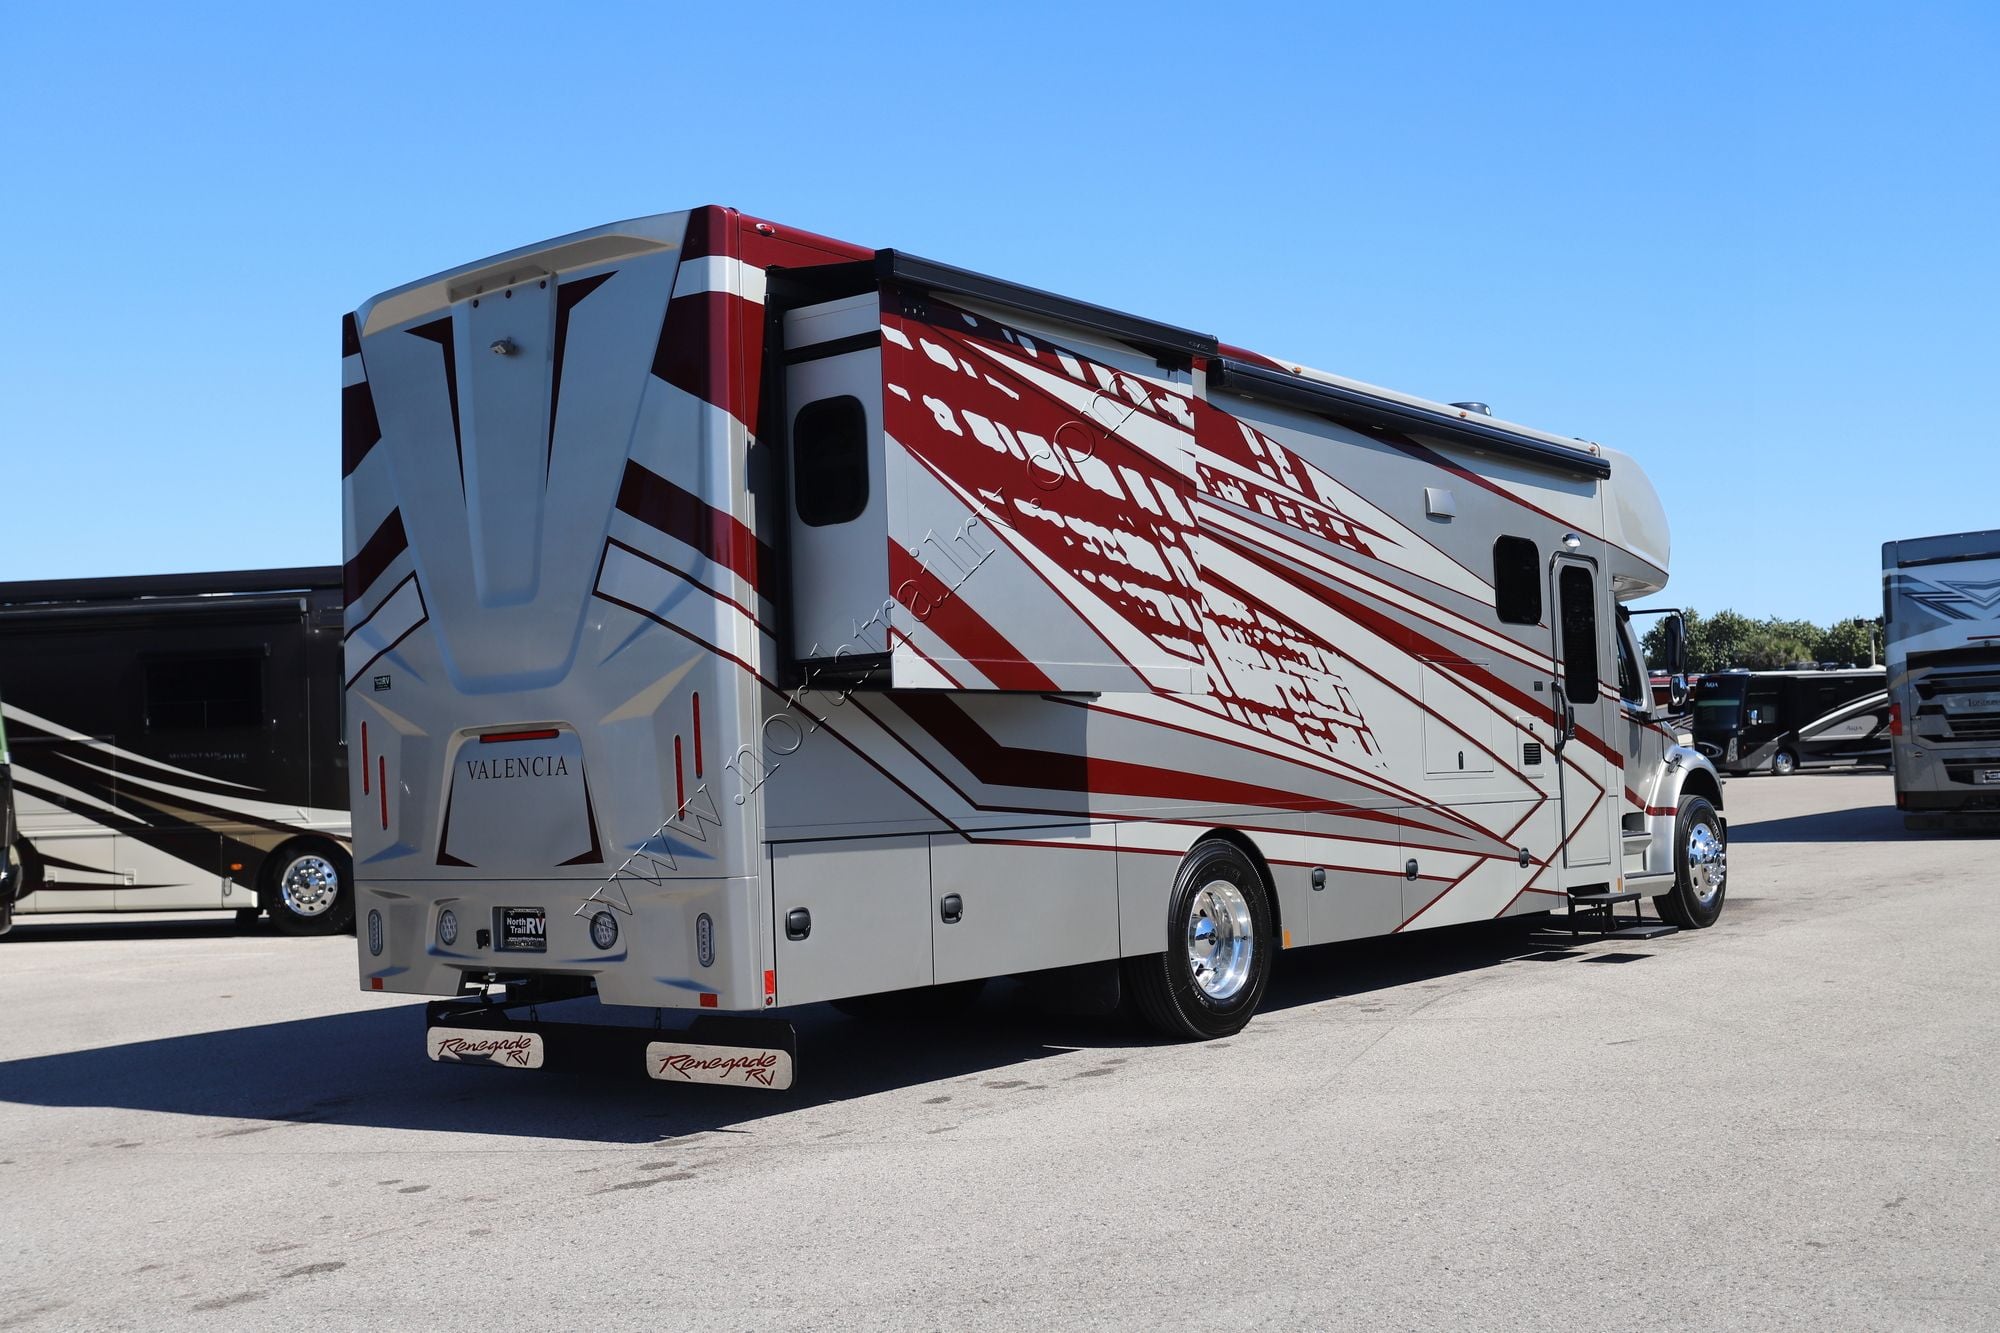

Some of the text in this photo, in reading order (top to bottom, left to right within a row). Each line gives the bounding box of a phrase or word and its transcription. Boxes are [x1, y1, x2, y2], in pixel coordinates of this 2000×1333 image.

[466, 755, 569, 780] VALENCIA
[506, 917, 526, 926] North
[510, 925, 526, 934] Trail
[526, 917, 546, 935] RV
[437, 1035, 532, 1061] Renegade
[505, 1050, 530, 1066] RV
[659, 1051, 777, 1080] Renegade
[744, 1068, 775, 1086] RV
